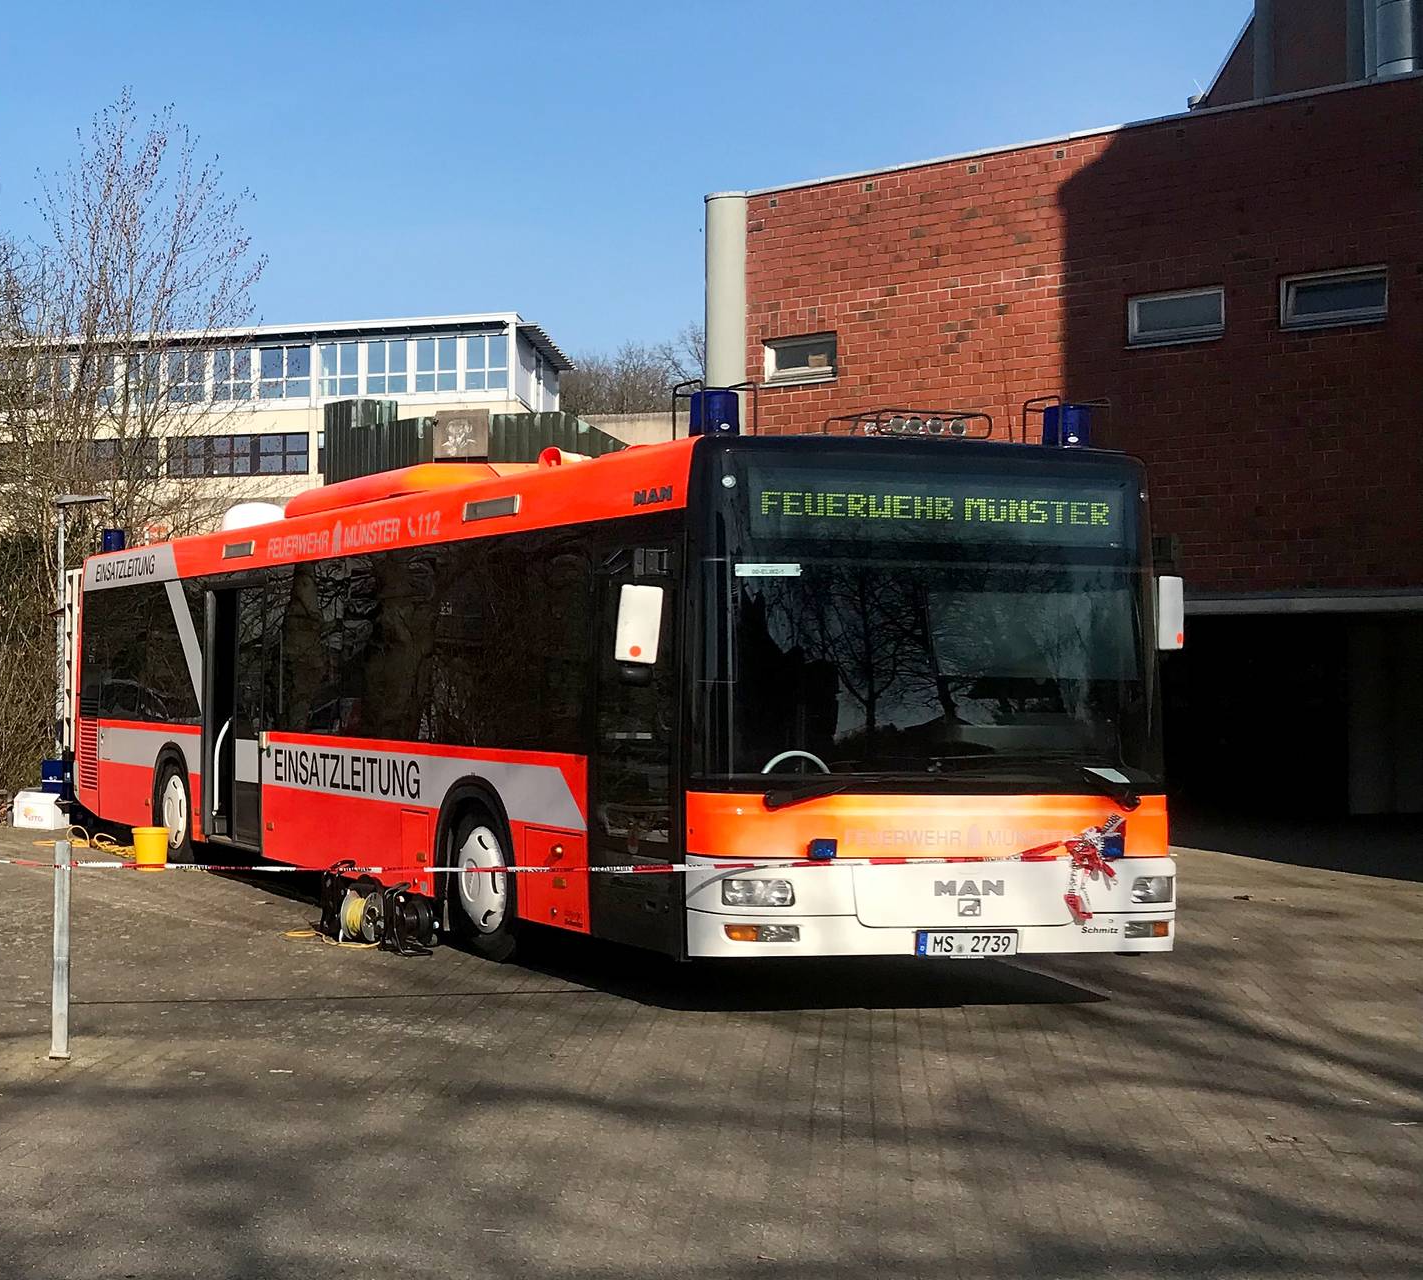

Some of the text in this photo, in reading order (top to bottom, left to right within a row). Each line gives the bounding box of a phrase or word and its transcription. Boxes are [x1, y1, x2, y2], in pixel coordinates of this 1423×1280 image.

[633, 485, 673, 507] MAN
[761, 491, 954, 520] FEUERWEHR
[266, 510, 442, 559] FEUERWEHR MÜNSTER 112
[95, 554, 156, 583] EINSATZLEITUNG
[274, 748, 421, 799] EINSATZLEITUNG
[934, 879, 1005, 897] MAN
[1081, 926, 1119, 934] Schmitz
[932, 935, 954, 953] MS
[970, 935, 1011, 953] 2739
